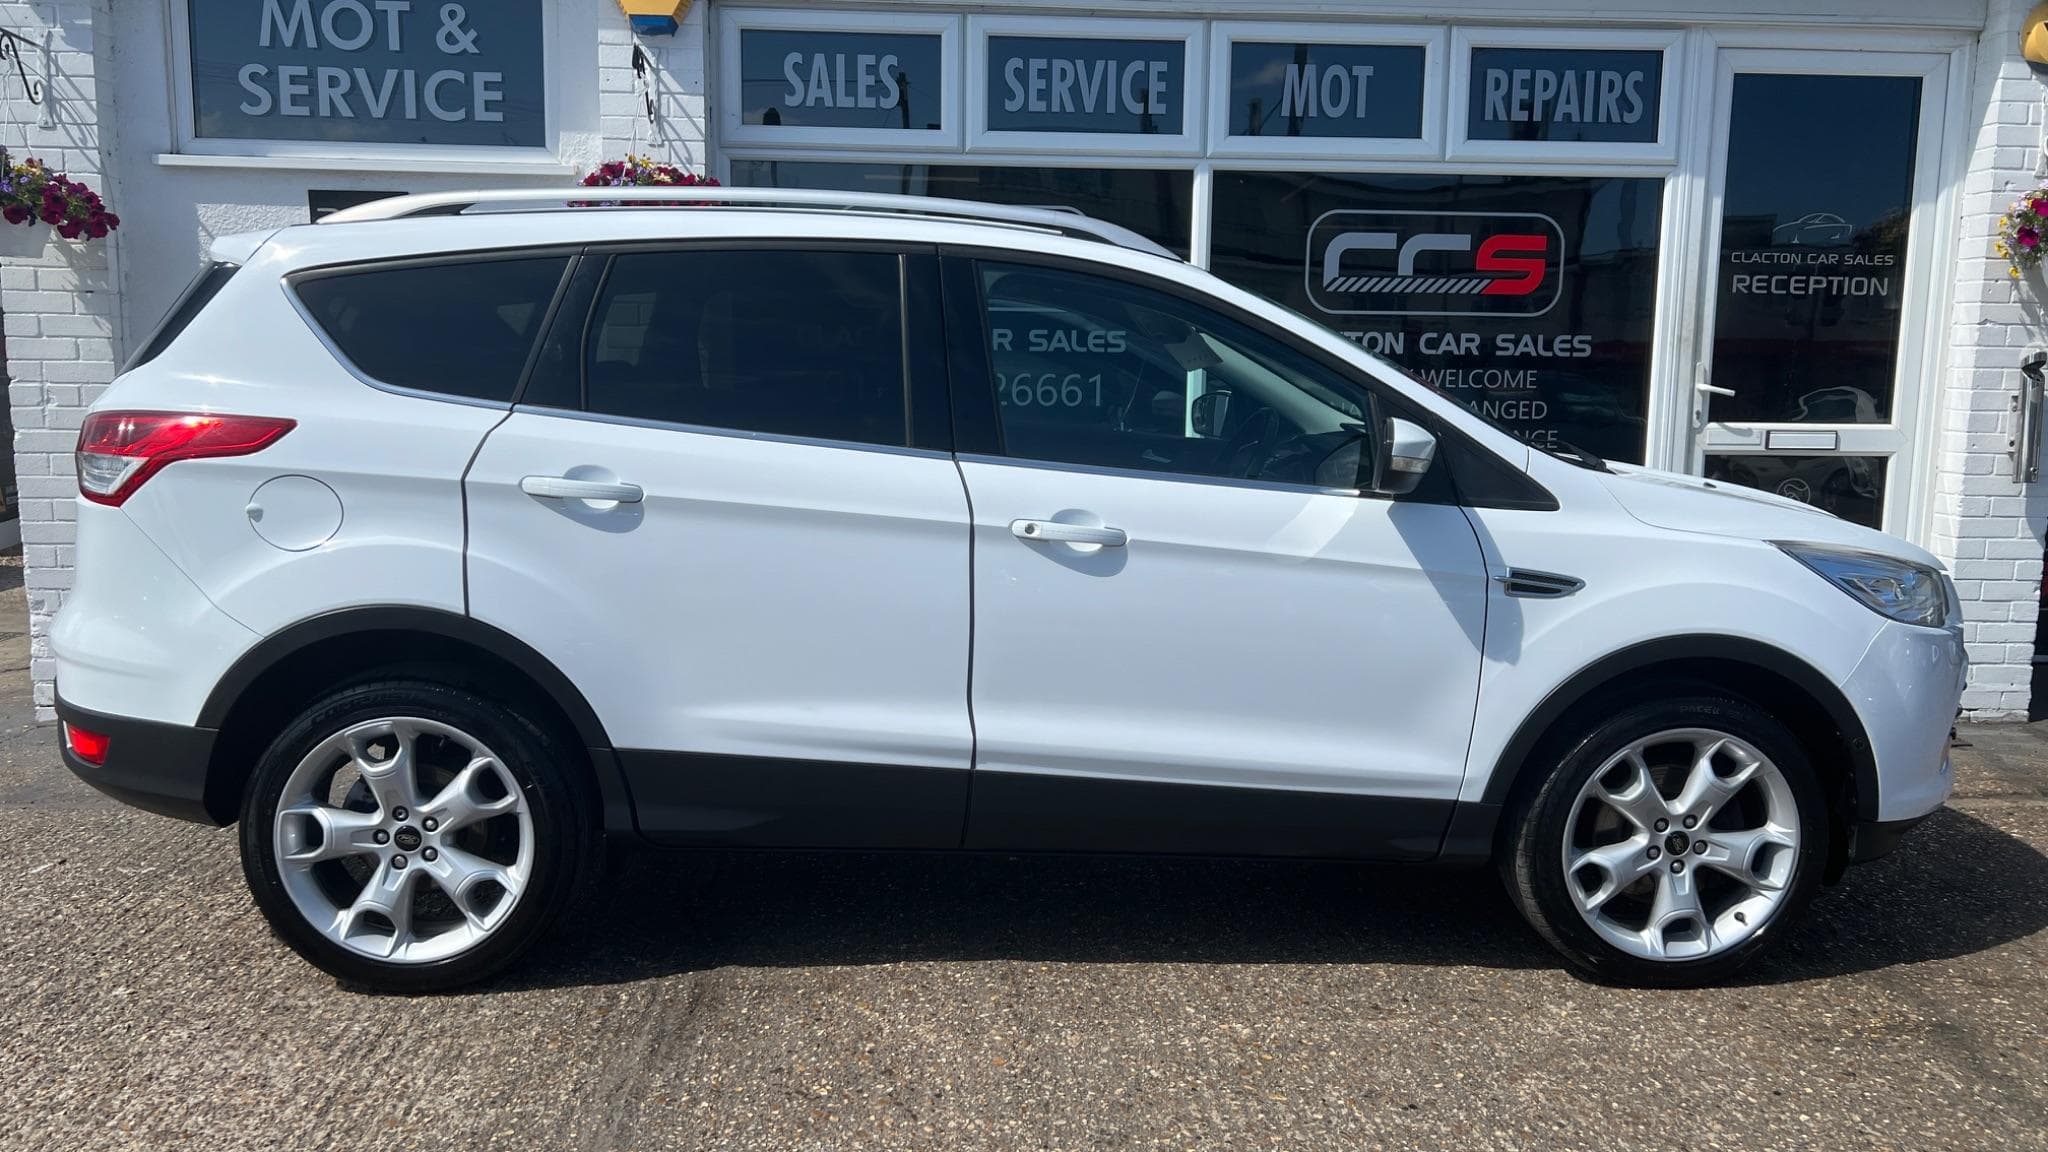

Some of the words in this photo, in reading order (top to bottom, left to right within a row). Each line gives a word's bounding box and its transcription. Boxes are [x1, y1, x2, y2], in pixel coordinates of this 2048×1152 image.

[259, 0, 410, 50] MOT
[435, 3, 480, 54] &
[238, 63, 504, 122] SERVICE
[783, 52, 901, 109] SALES
[1004, 57, 1168, 114] SERVICE
[1280, 64, 1374, 118] MOT
[1484, 69, 1644, 124] REPAIRS
[1731, 252, 1801, 264] CLACTON
[1807, 253, 1839, 265] CAR
[1844, 254, 1894, 266] SALES
[1731, 274, 1889, 296] RECEPTION
[1028, 329, 1127, 353] SALES
[1419, 332, 1481, 356] CAR
[1495, 333, 1592, 358] SALES
[1420, 369, 1538, 389] WELCOME
